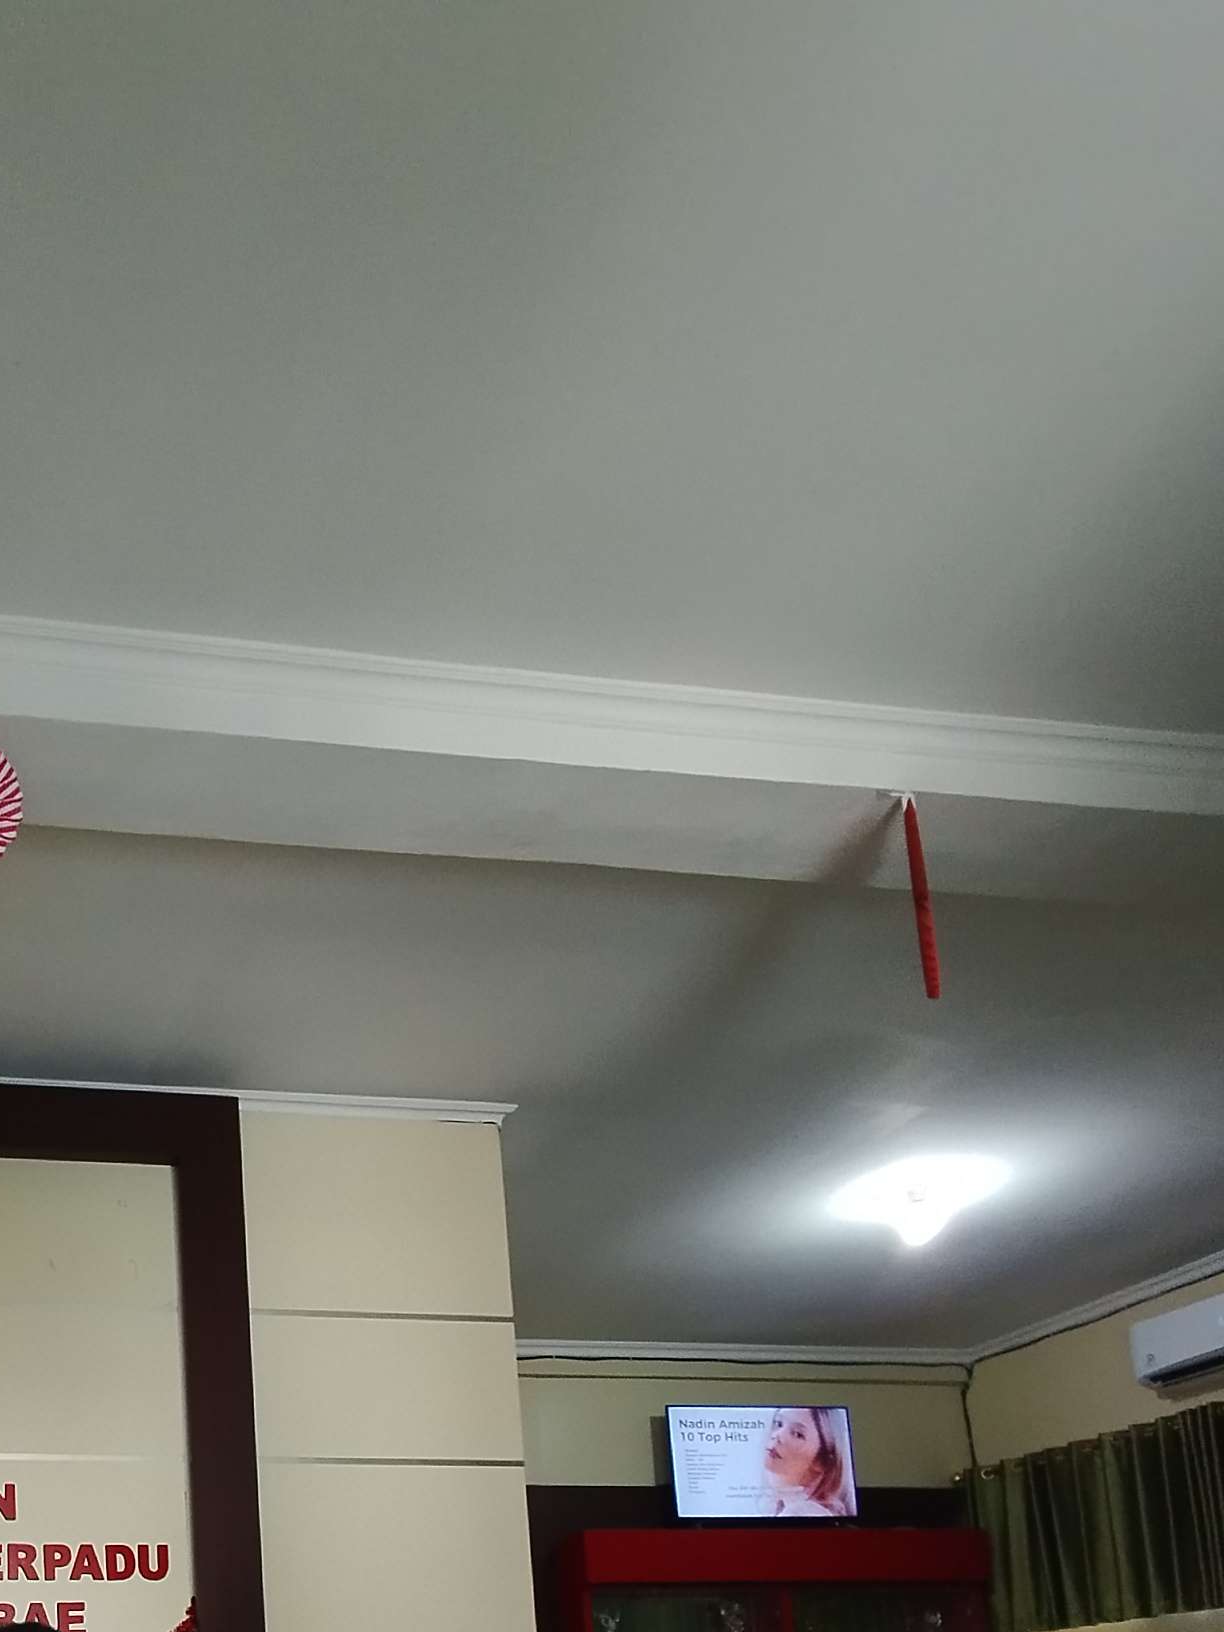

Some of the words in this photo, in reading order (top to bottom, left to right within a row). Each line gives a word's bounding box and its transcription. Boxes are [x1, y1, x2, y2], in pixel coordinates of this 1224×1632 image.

[679, 1419, 715, 1429] Nadin
[719, 1419, 765, 1430] Amizah
[680, 1432, 695, 1442] 10
[697, 1432, 721, 1444] Top
[725, 1432, 748, 1442] Hits
